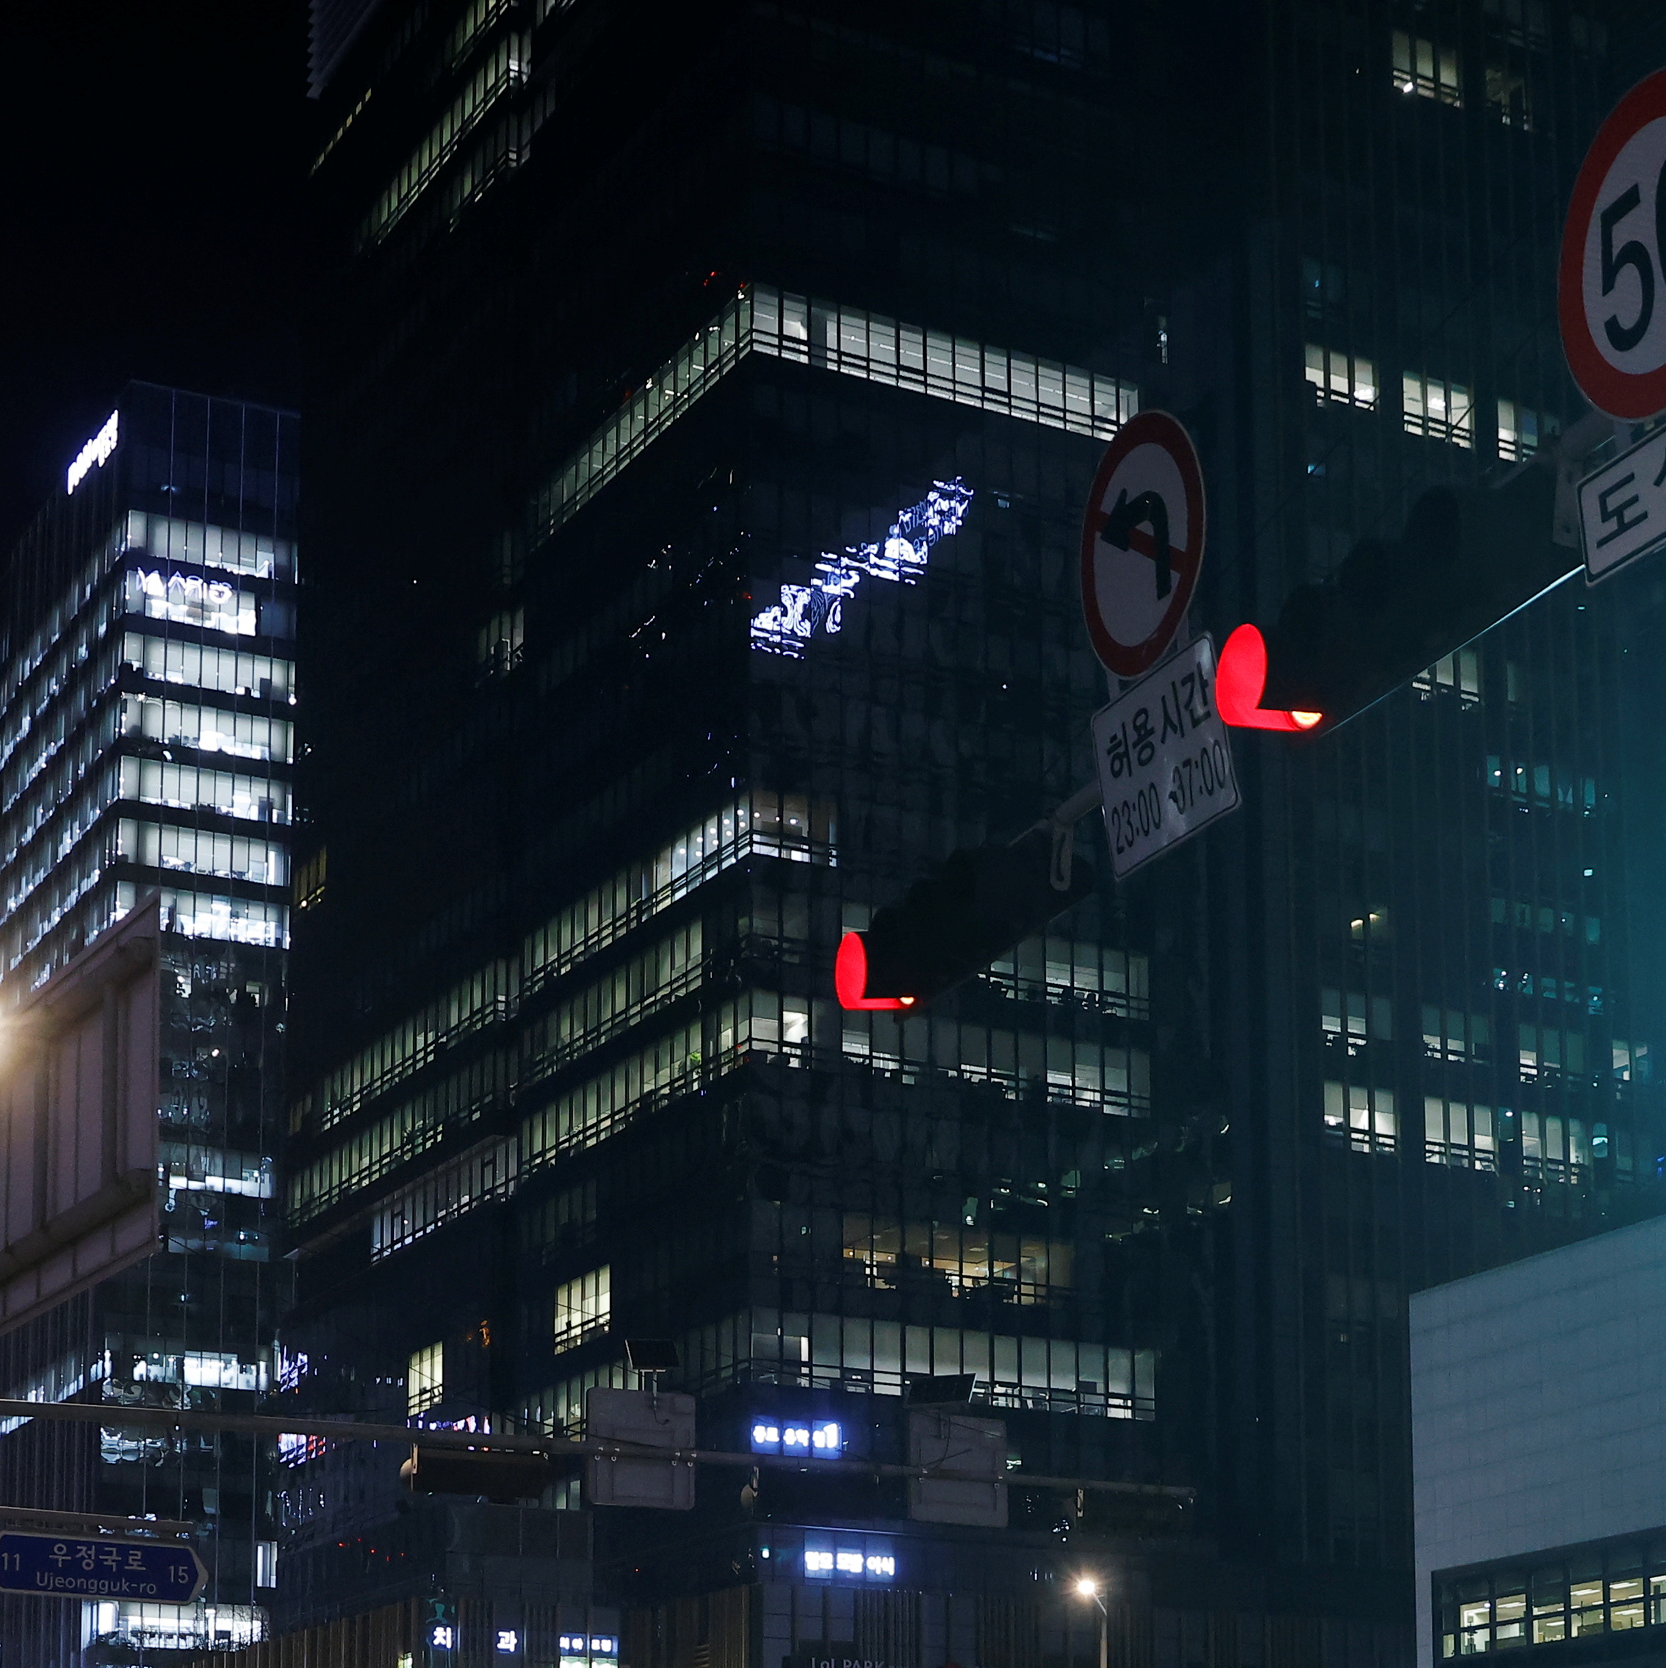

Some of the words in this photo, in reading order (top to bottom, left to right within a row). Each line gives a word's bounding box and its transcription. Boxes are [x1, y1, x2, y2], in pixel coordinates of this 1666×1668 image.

[1107, 661, 1212, 778] 허용시간
[1, 1552, 21, 1571] 11
[48, 1543, 147, 1572] 우정국로
[167, 1565, 190, 1584] 15
[36, 1571, 158, 1595] Ujeongguk-ro
